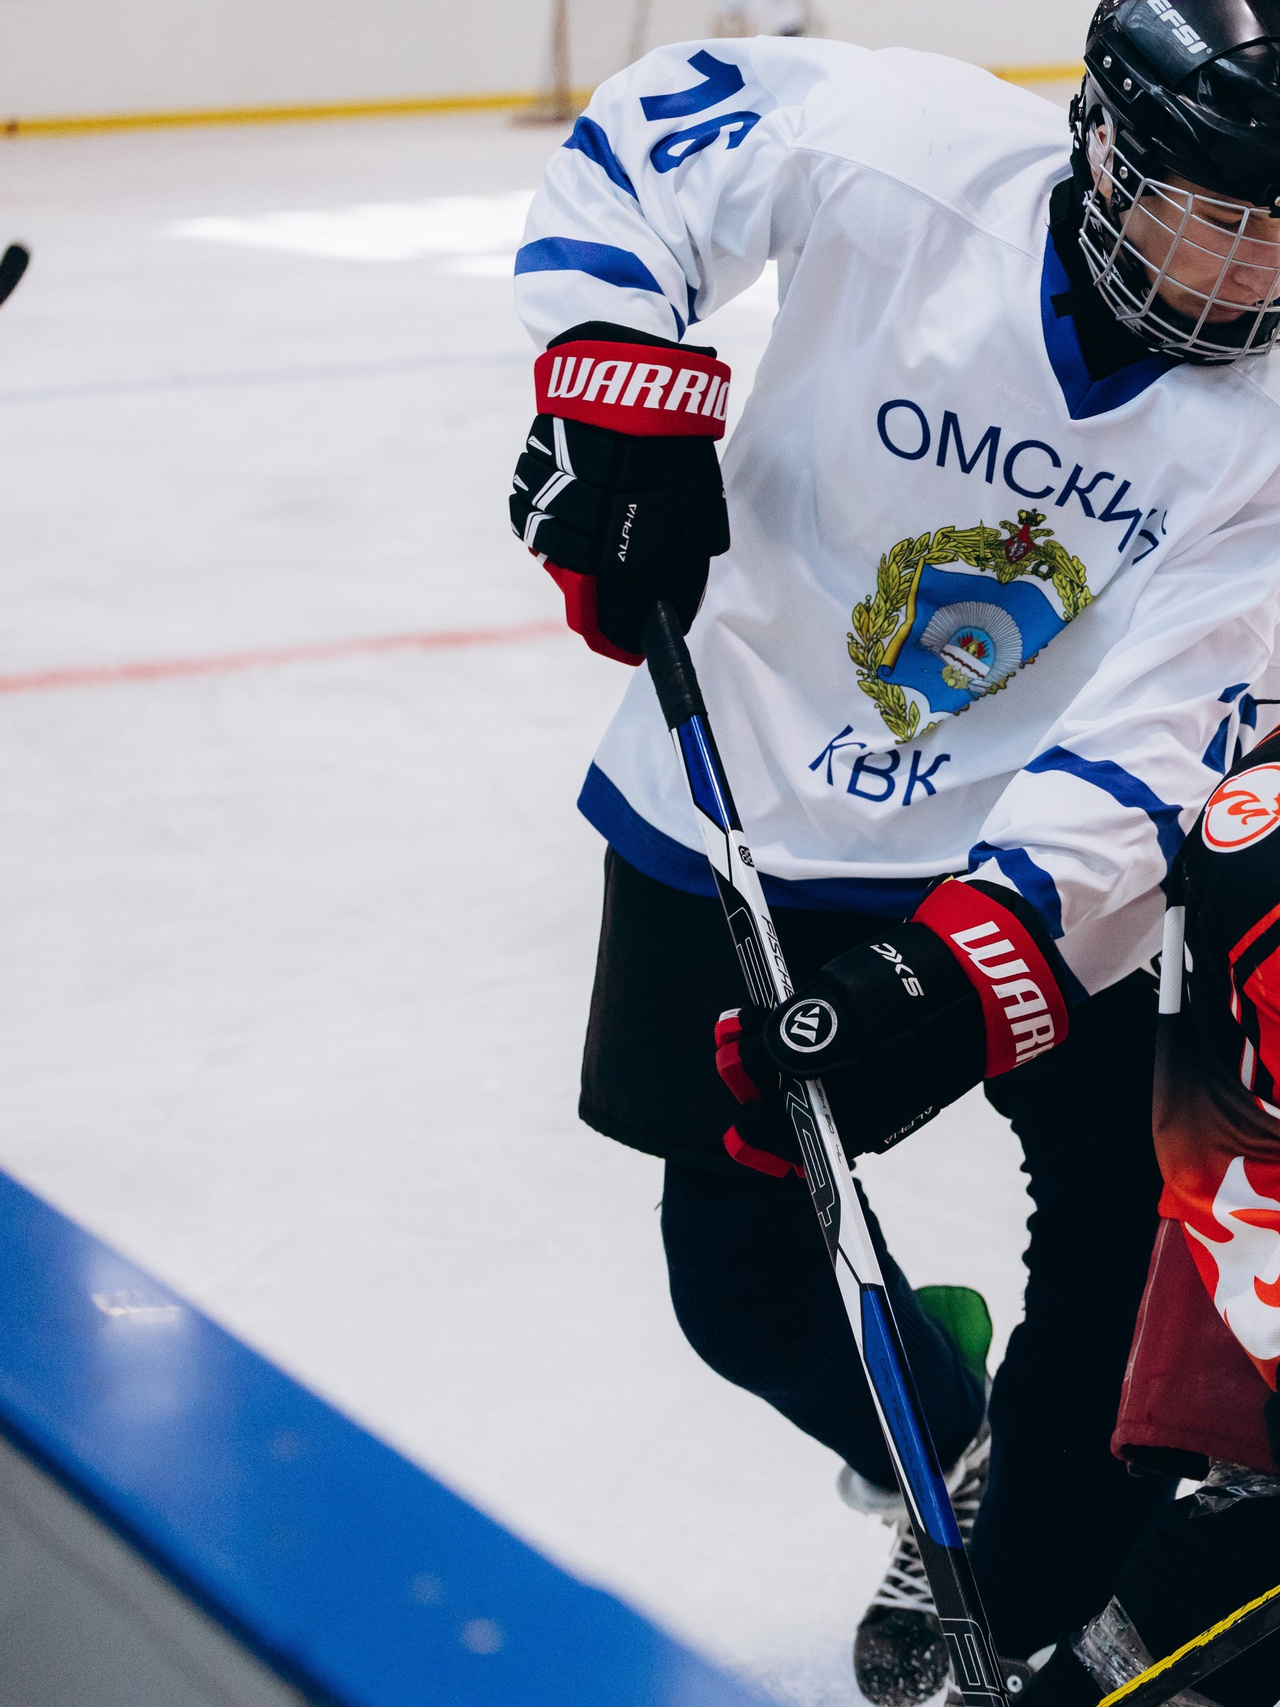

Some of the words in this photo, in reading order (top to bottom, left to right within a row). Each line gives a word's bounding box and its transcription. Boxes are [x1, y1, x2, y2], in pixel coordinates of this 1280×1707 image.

[1147, 0, 1209, 54] EFSI
[639, 49, 762, 174] 16
[617, 502, 637, 562] ALPHA
[808, 725, 951, 807] КВК
